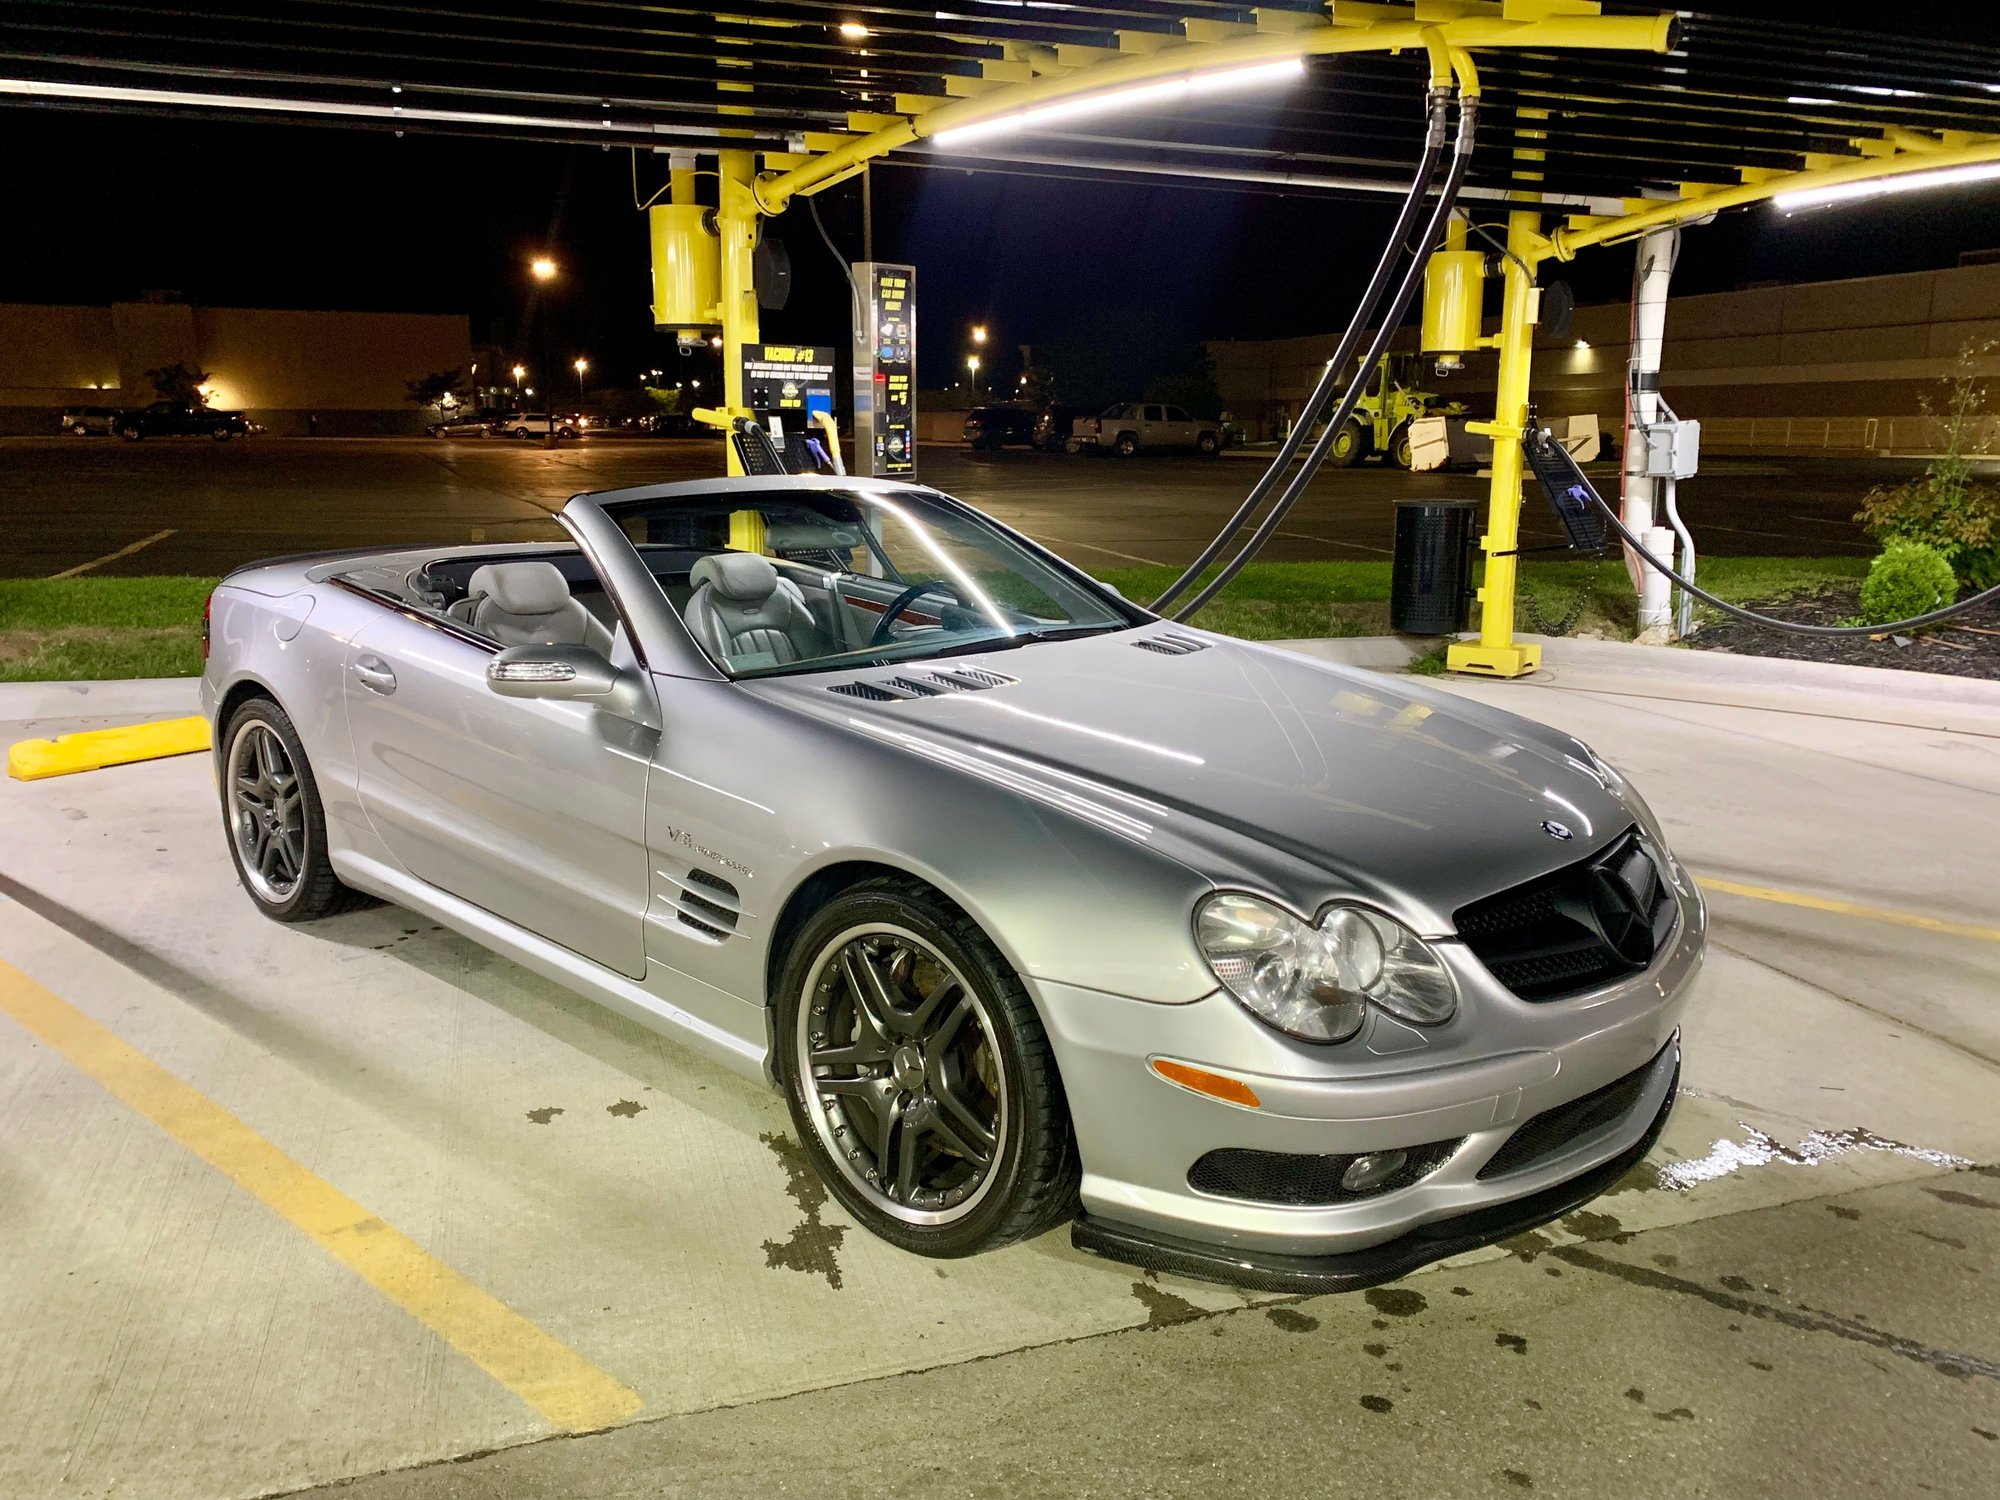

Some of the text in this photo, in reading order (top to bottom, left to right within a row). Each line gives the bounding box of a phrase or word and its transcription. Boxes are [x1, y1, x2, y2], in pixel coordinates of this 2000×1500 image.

[764, 346, 814, 363] VACUUM #13
[667, 825, 692, 848] V8
